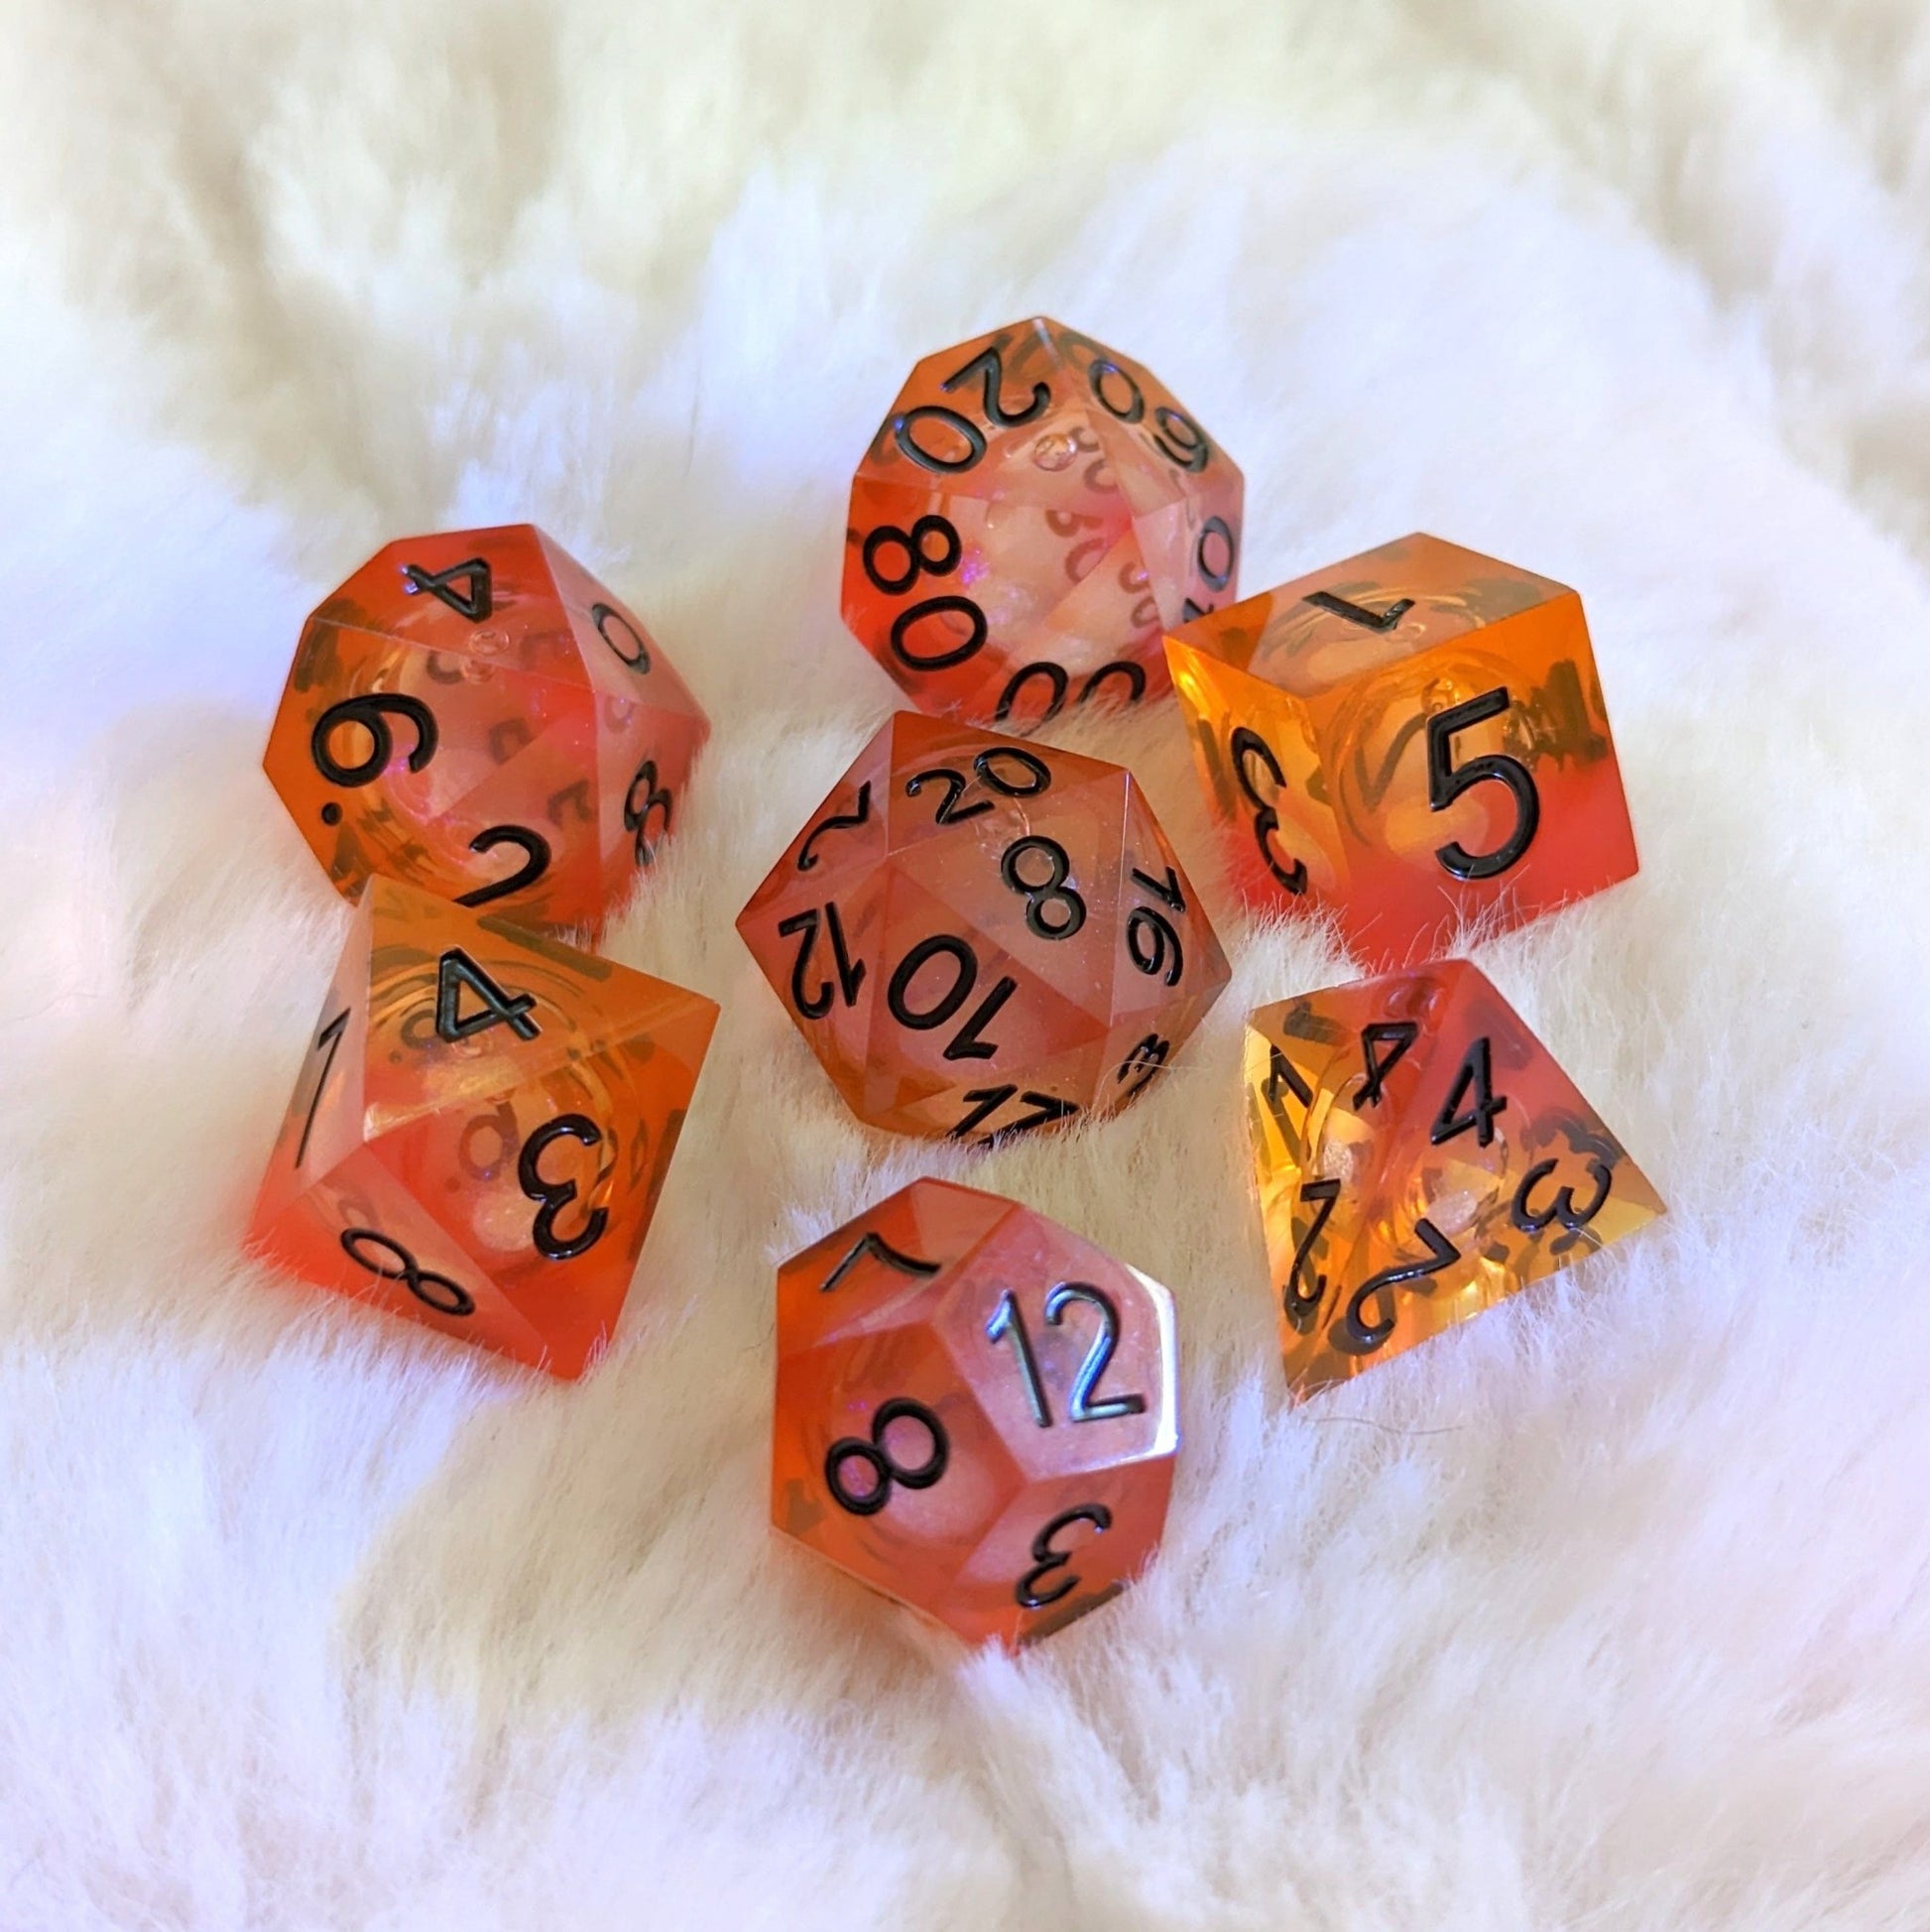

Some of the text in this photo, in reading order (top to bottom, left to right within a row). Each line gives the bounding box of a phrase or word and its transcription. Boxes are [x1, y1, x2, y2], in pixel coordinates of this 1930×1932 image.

[894, 346, 1051, 473] 20
[399, 557, 493, 623] 4
[592, 602, 651, 674] 0
[863, 515, 988, 671] 80
[1303, 591, 1415, 635] 1
[905, 747, 1051, 824] 20
[1230, 726, 1307, 895] 3
[1425, 685, 1540, 881] 5
[468, 824, 552, 907] 2
[1001, 836, 1087, 940] 8
[779, 902, 866, 1020] 12
[1127, 867, 1186, 986] 16
[436, 948, 541, 1042] 4
[888, 934, 1018, 1059] 10
[295, 1009, 350, 1168] 1
[946, 1084, 1079, 1144] 17
[1353, 1022, 1418, 1111] 4
[1430, 1036, 1507, 1147] 4
[518, 1114, 608, 1261] 3
[1510, 1158, 1612, 1232] 3
[341, 1228, 475, 1317] 8
[1284, 1178, 1341, 1315] 2
[1346, 1218, 1461, 1344] 2
[986, 1282, 1146, 1428] 12
[825, 1397, 950, 1515] 8
[1015, 1504, 1113, 1609] 3
